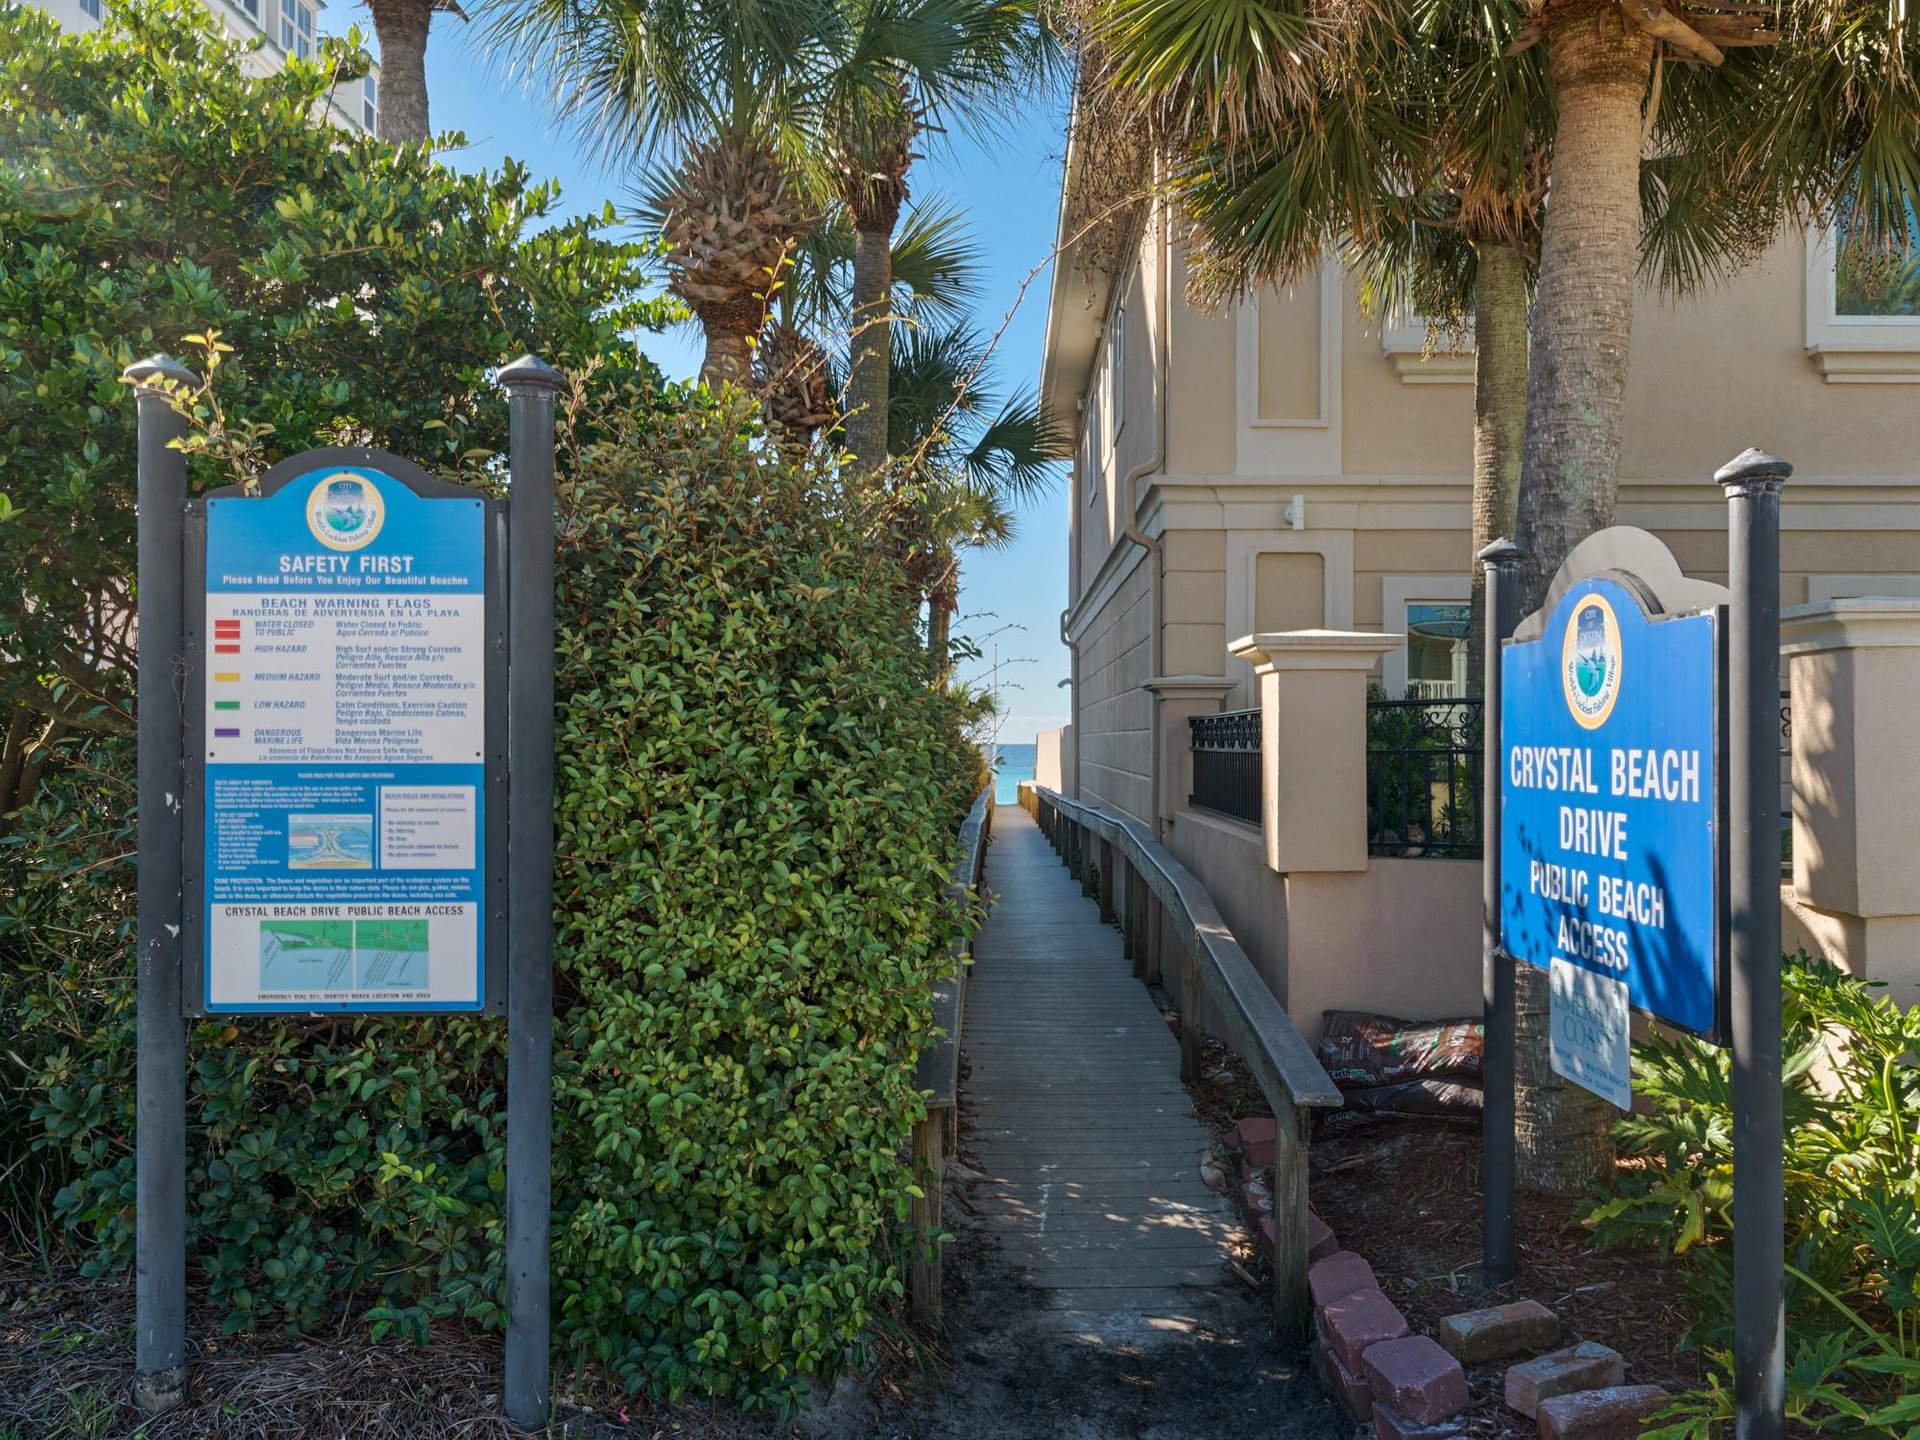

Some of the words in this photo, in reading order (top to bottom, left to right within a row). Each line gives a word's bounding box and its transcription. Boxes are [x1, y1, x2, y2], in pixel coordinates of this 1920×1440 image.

[279, 556, 350, 573] SAFETY
[360, 556, 414, 573] FIRST
[223, 575, 253, 586] Please
[256, 575, 279, 586] Read
[283, 575, 313, 586] Before
[317, 575, 333, 586] You
[336, 575, 361, 586] Enjoy
[365, 575, 380, 586] Our
[385, 575, 426, 586] Beautiful
[430, 575, 468, 586] Beaches
[261, 599, 307, 609] BEACH
[312, 599, 379, 609] WARNING
[384, 599, 431, 609] FLAGS
[232, 609, 289, 617] BANDERAS
[294, 609, 307, 617] DE
[390, 609, 403, 617] EN
[409, 609, 421, 617] LA
[427, 609, 460, 617] PLAYA
[254, 620, 282, 629] WATER
[282, 620, 314, 629] CLOSED
[336, 621, 358, 629] Water
[360, 621, 387, 629] Closed
[388, 621, 396, 629] to
[397, 621, 422, 629] Public
[255, 628, 265, 637] TO
[266, 628, 295, 637] PUBLIC
[336, 629, 357, 638] Agua
[357, 629, 389, 638] Cerrada
[390, 629, 399, 638] al
[254, 645, 274, 653] HIGH
[274, 645, 307, 653] HAZARD
[335, 645, 353, 655] High
[355, 645, 371, 655] Surf
[373, 645, 398, 655] and/or
[400, 645, 426, 655] Strong
[428, 645, 462, 655] Currents
[335, 661, 377, 669] Corrientes
[377, 661, 407, 669] Fuertes
[254, 673, 287, 681] MEDIUM
[287, 673, 321, 681] HAZARD
[335, 673, 372, 681] Moderate
[374, 673, 390, 681] Surf
[392, 673, 417, 681] and/or
[419, 673, 453, 681] Currents
[335, 689, 377, 697] Corrientes
[377, 689, 407, 697] Fuertes
[254, 701, 272, 709] LOW
[272, 701, 306, 709] HAZARD
[335, 701, 355, 710] Calm
[356, 701, 400, 710] Conditions,
[402, 701, 435, 710] Exercise
[437, 701, 468, 710] Caution
[254, 728, 302, 737] DANGEROUS
[335, 729, 377, 738] Dangerous
[378, 729, 406, 738] Marine
[407, 729, 423, 738] Life
[254, 737, 285, 745] MARINE
[286, 737, 304, 745] LIFE
[1510, 746, 1598, 794] CRYSTAL
[1611, 749, 1699, 802] BEACH
[1560, 806, 1628, 860] DRIVE
[1530, 860, 1588, 908] PUBLIC
[1599, 874, 1665, 930] BEACH
[225, 906, 268, 917] CRYSTAL
[273, 906, 306, 917] BEACH
[311, 906, 340, 917] DRIVE
[346, 906, 382, 917] PUBLIC
[388, 906, 420, 917] BEACH
[425, 906, 464, 917] ACCESS
[1558, 914, 1628, 971] ACCESS
